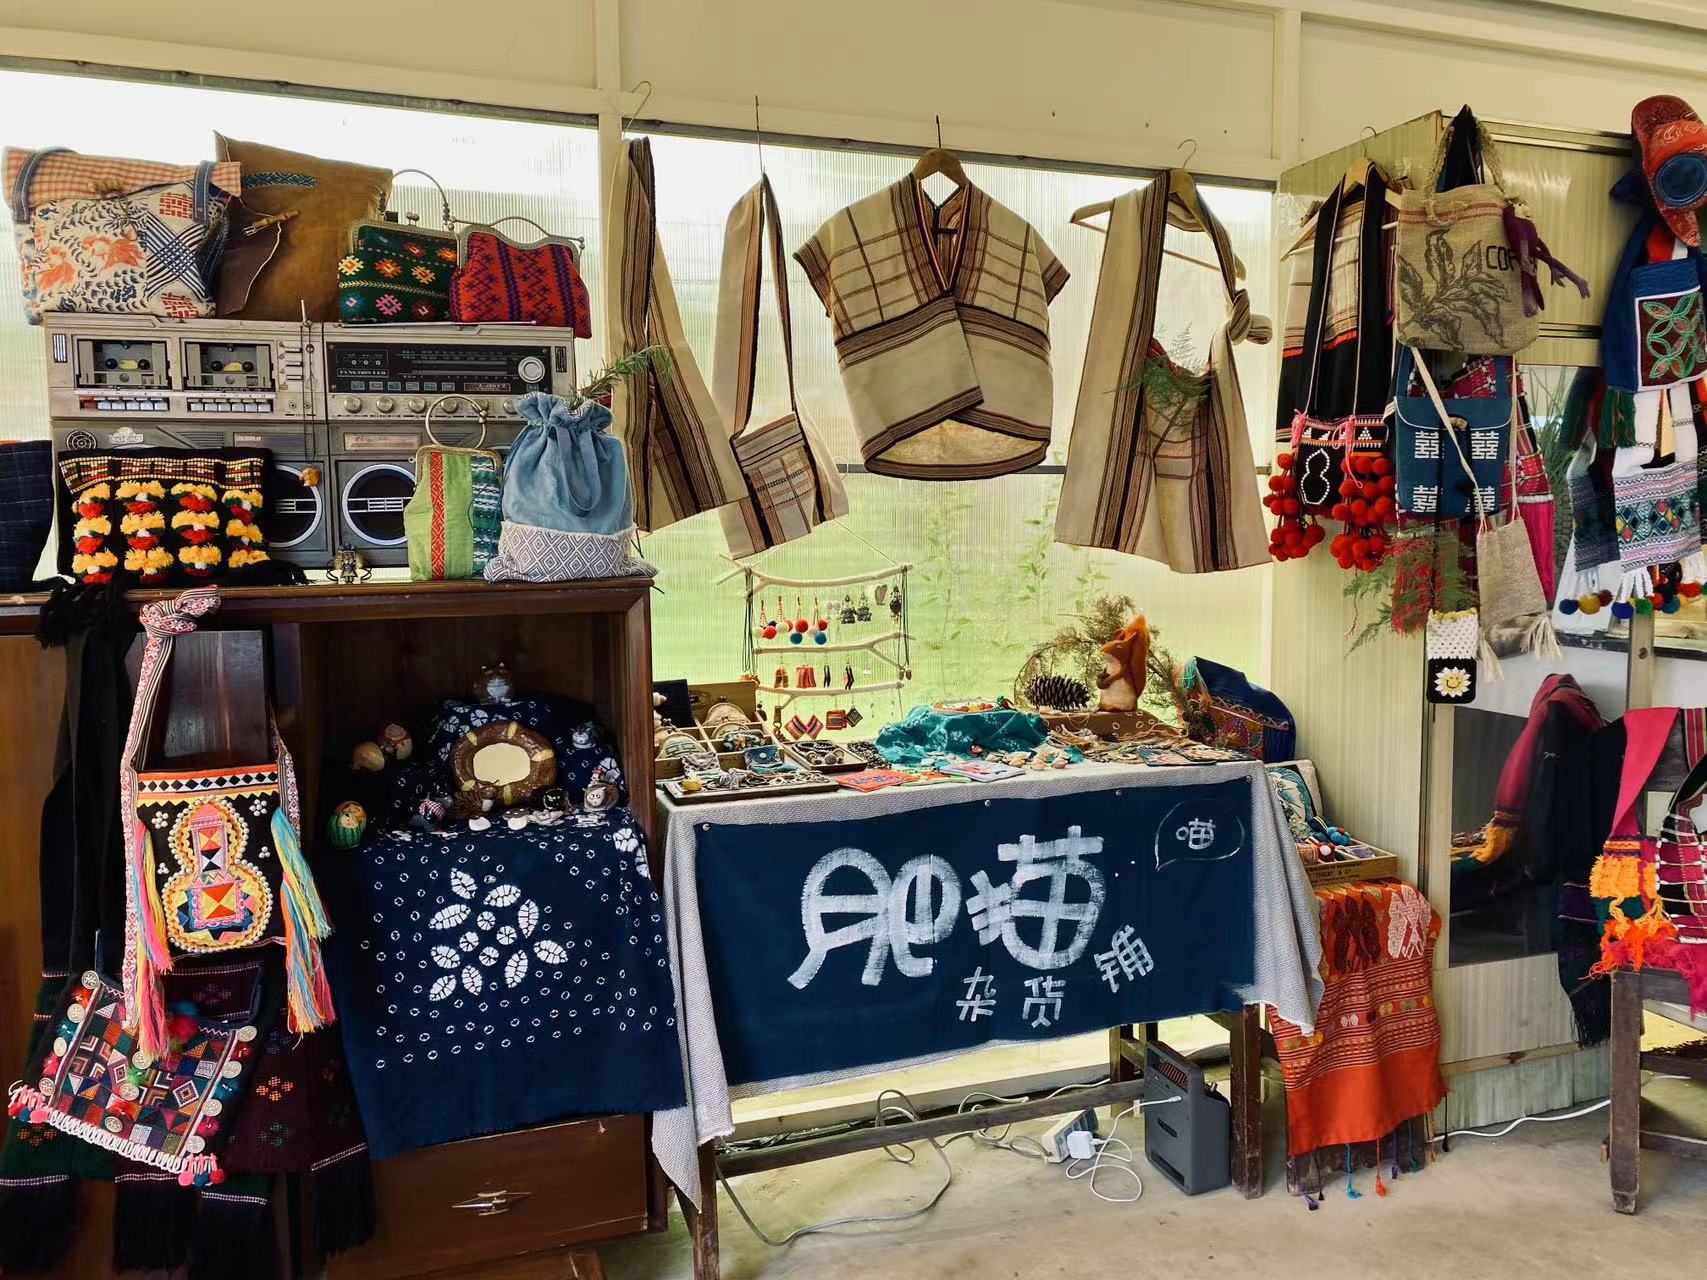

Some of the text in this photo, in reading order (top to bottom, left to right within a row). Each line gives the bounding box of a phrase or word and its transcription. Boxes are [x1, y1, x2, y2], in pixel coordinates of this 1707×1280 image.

[1175, 818, 1216, 850] 喵
[956, 924, 1155, 1028] 杂货铺
